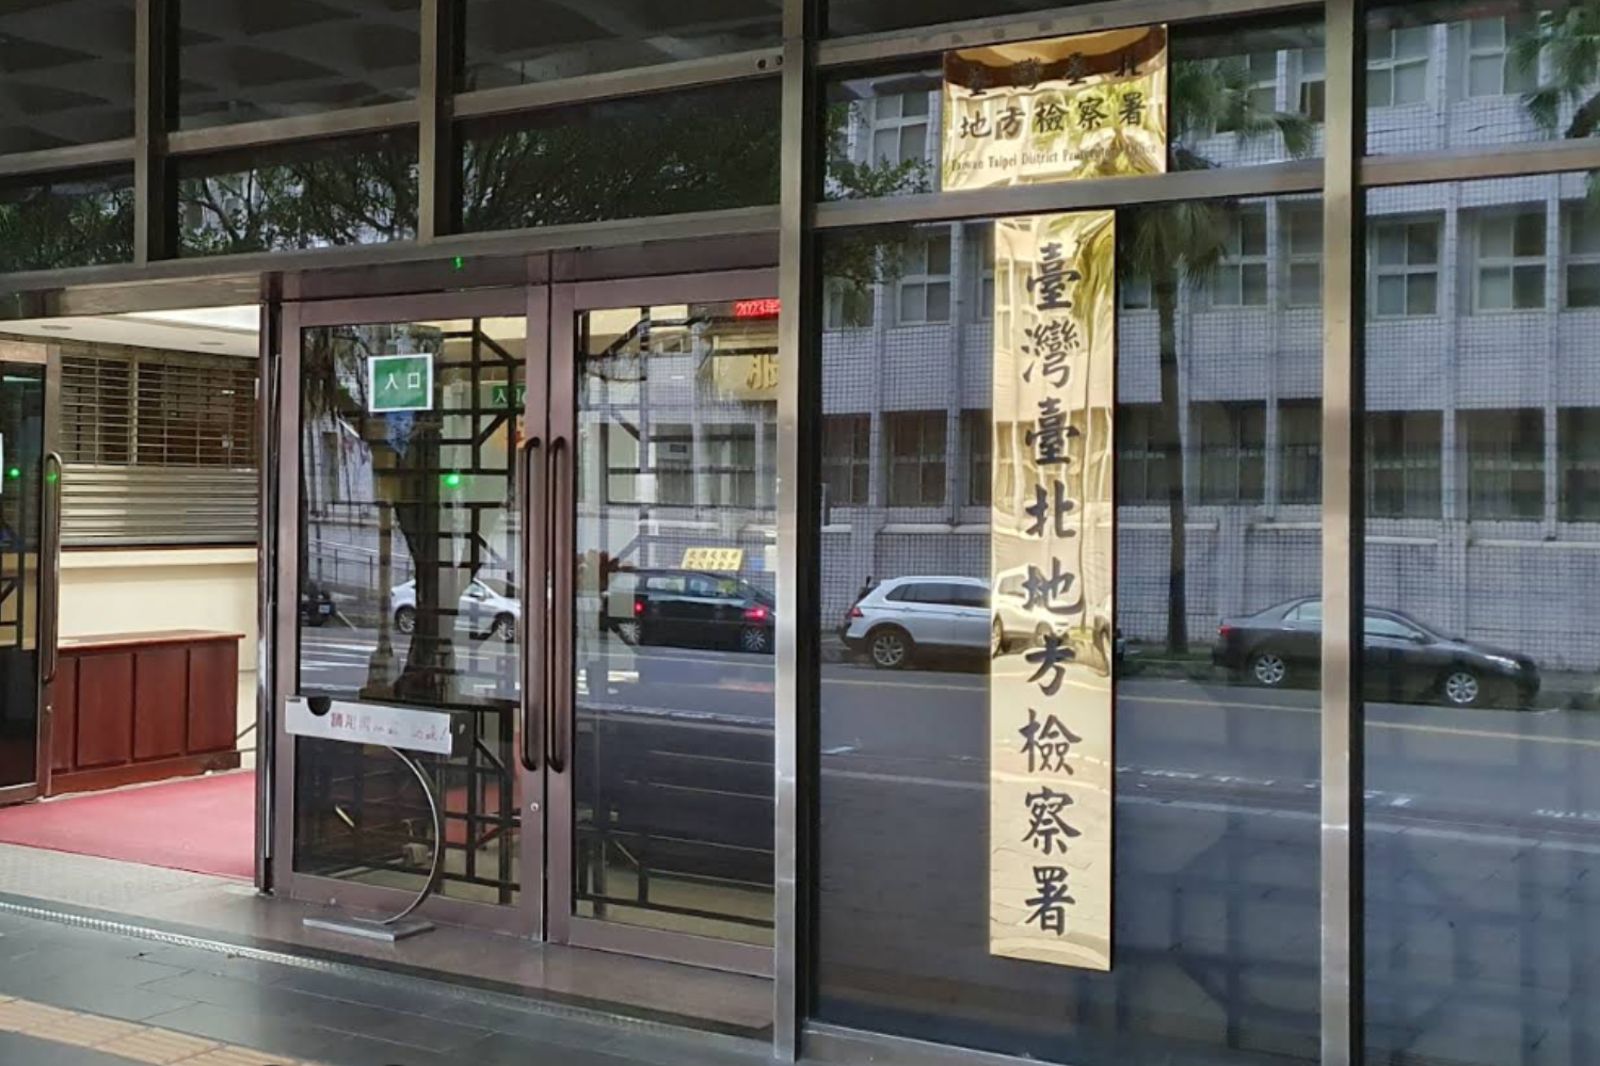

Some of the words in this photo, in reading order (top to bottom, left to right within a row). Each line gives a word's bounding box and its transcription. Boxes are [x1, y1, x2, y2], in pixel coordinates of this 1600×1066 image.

[960, 91, 1147, 139] 地方檢察署
[988, 152, 1017, 170] Taipei
[1022, 150, 1058, 165] District
[384, 372, 421, 390] 入口
[1018, 242, 1082, 937] 臺灣臺北地方檢察署
